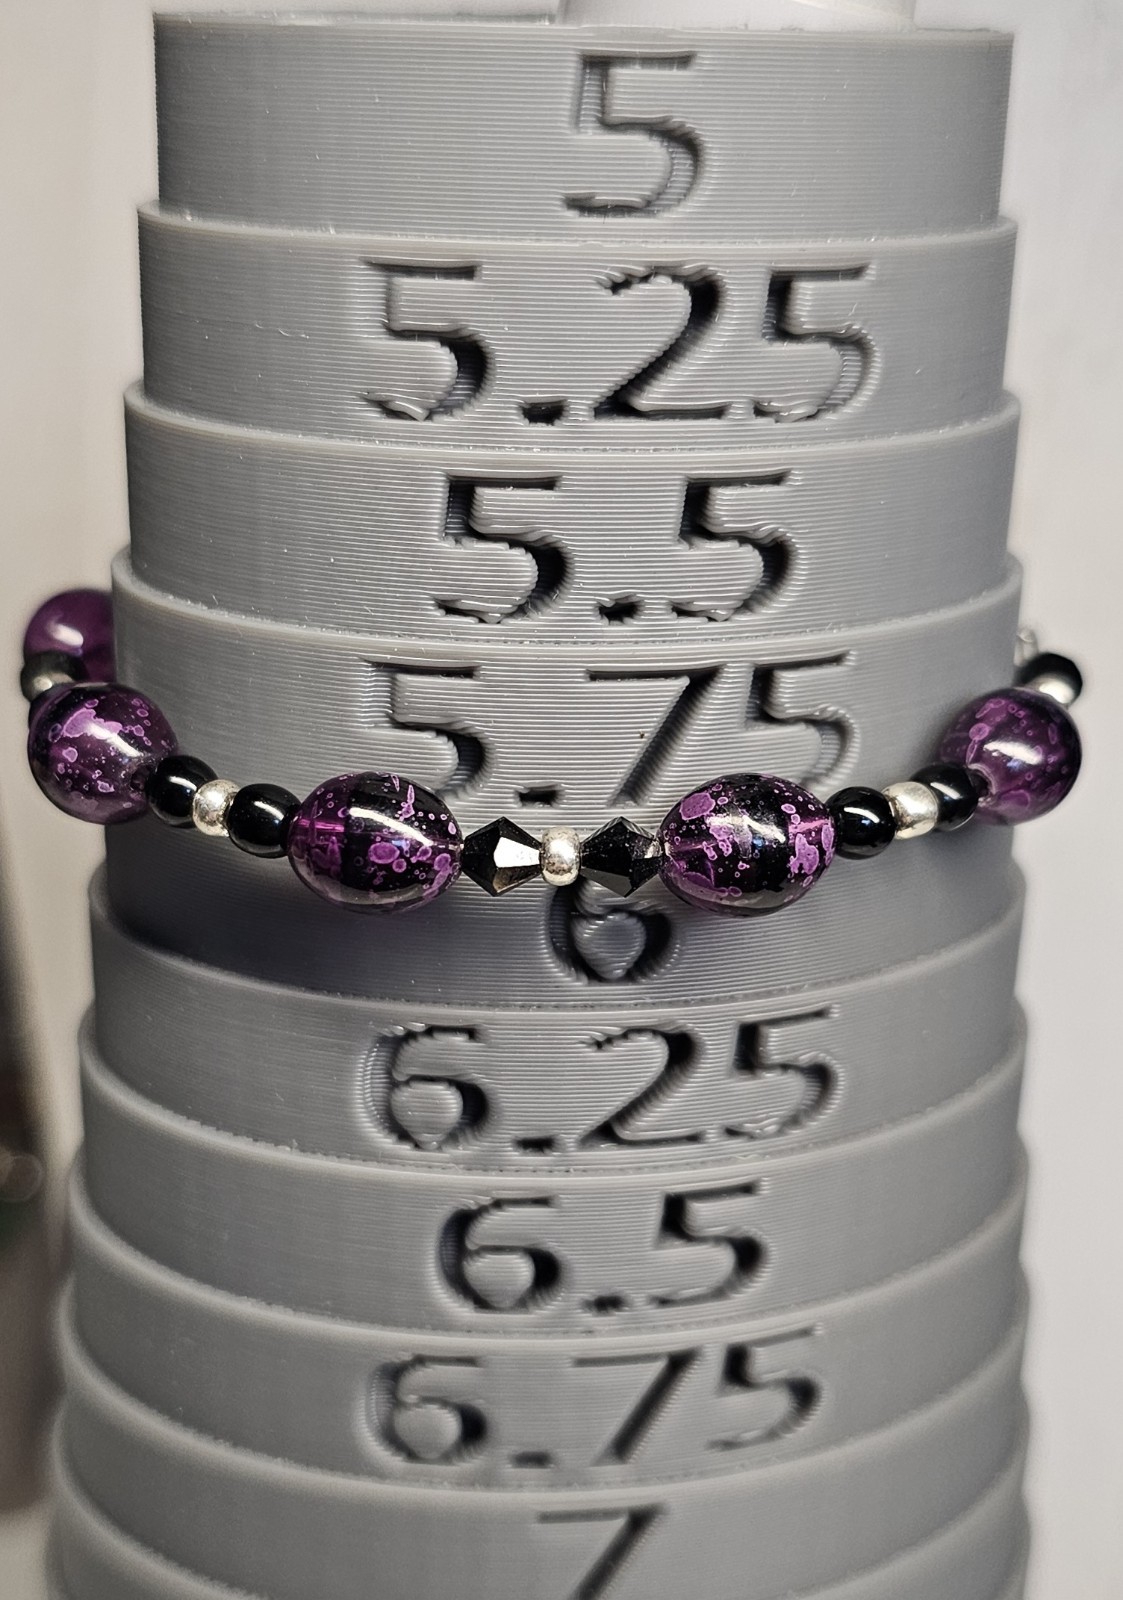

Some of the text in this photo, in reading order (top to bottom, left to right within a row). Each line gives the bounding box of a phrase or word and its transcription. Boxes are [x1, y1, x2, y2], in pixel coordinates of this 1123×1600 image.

[562, 50, 705, 217] 5
[361, 258, 880, 424] 5.25
[433, 468, 805, 624] 5.5
[361, 651, 860, 808] 5.75
[358, 1004, 843, 1151] 6.25
[433, 1178, 772, 1313] 6.5
[361, 1324, 822, 1467] 6.75
[536, 1503, 666, 1600] 7
